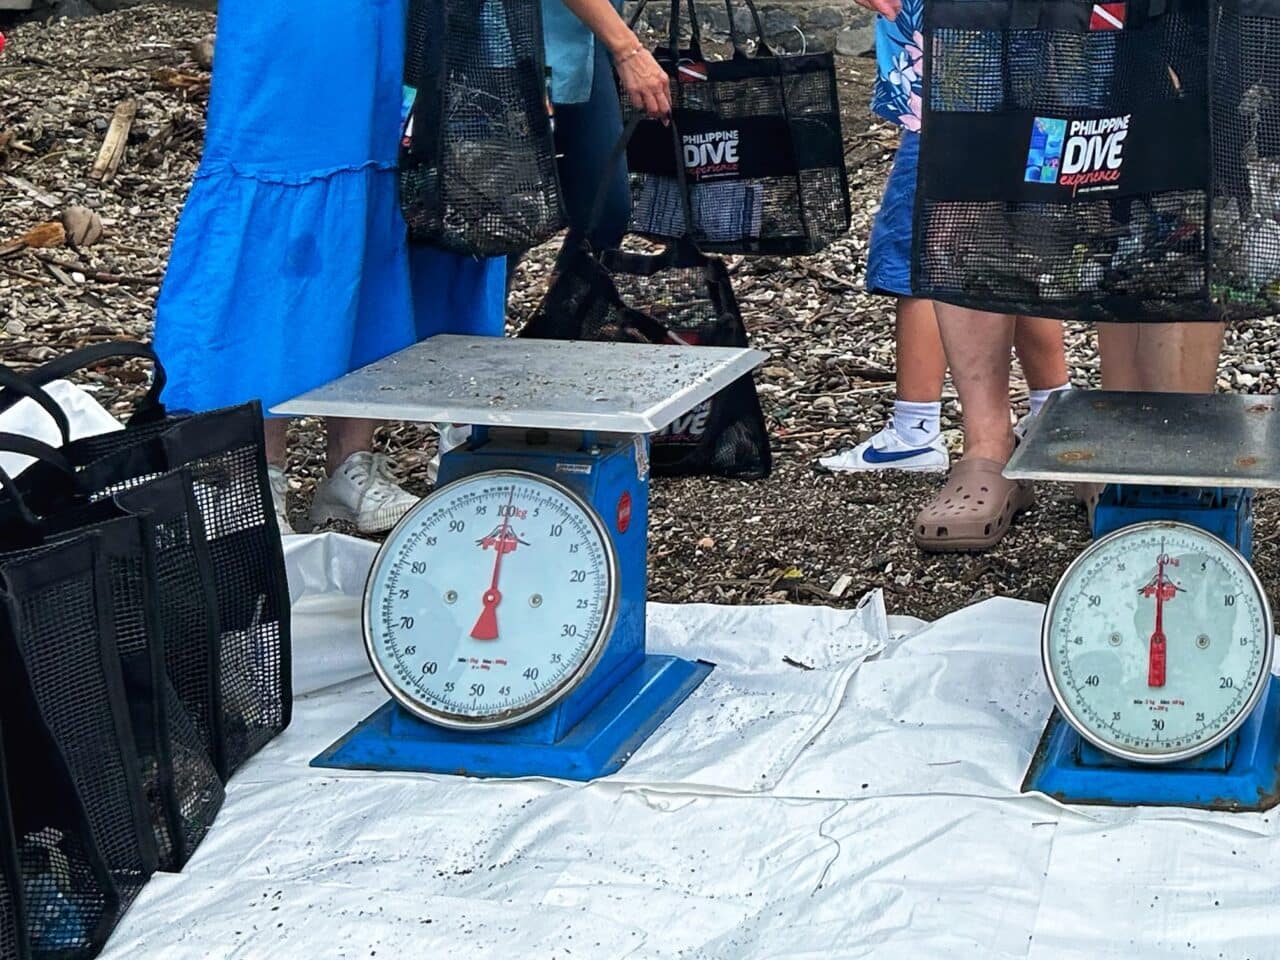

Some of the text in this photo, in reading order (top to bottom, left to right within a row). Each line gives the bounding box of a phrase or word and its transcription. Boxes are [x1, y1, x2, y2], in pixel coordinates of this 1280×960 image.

[1070, 114, 1131, 136] PHILIPPINE
[683, 130, 739, 144] PHILIPPINE
[684, 140, 739, 167] DIVE
[1061, 130, 1128, 174] DIVE
[1060, 169, 1120, 198] experience
[449, 520, 464, 533] 90
[550, 524, 562, 537] 10
[411, 561, 426, 574] 80
[570, 570, 586, 583] 20
[576, 599, 588, 609] 25
[1088, 595, 1101, 608] 50
[1224, 595, 1235, 607] 10
[400, 617, 414, 629] 70
[561, 625, 576, 637] 30
[422, 662, 437, 674] 60
[523, 668, 538, 680] 40
[1085, 676, 1099, 687] 40
[1219, 677, 1233, 689] 20
[470, 684, 484, 697] 50
[499, 686, 511, 696] 45
[1196, 713, 1205, 722] 25
[1152, 719, 1164, 731] 30
